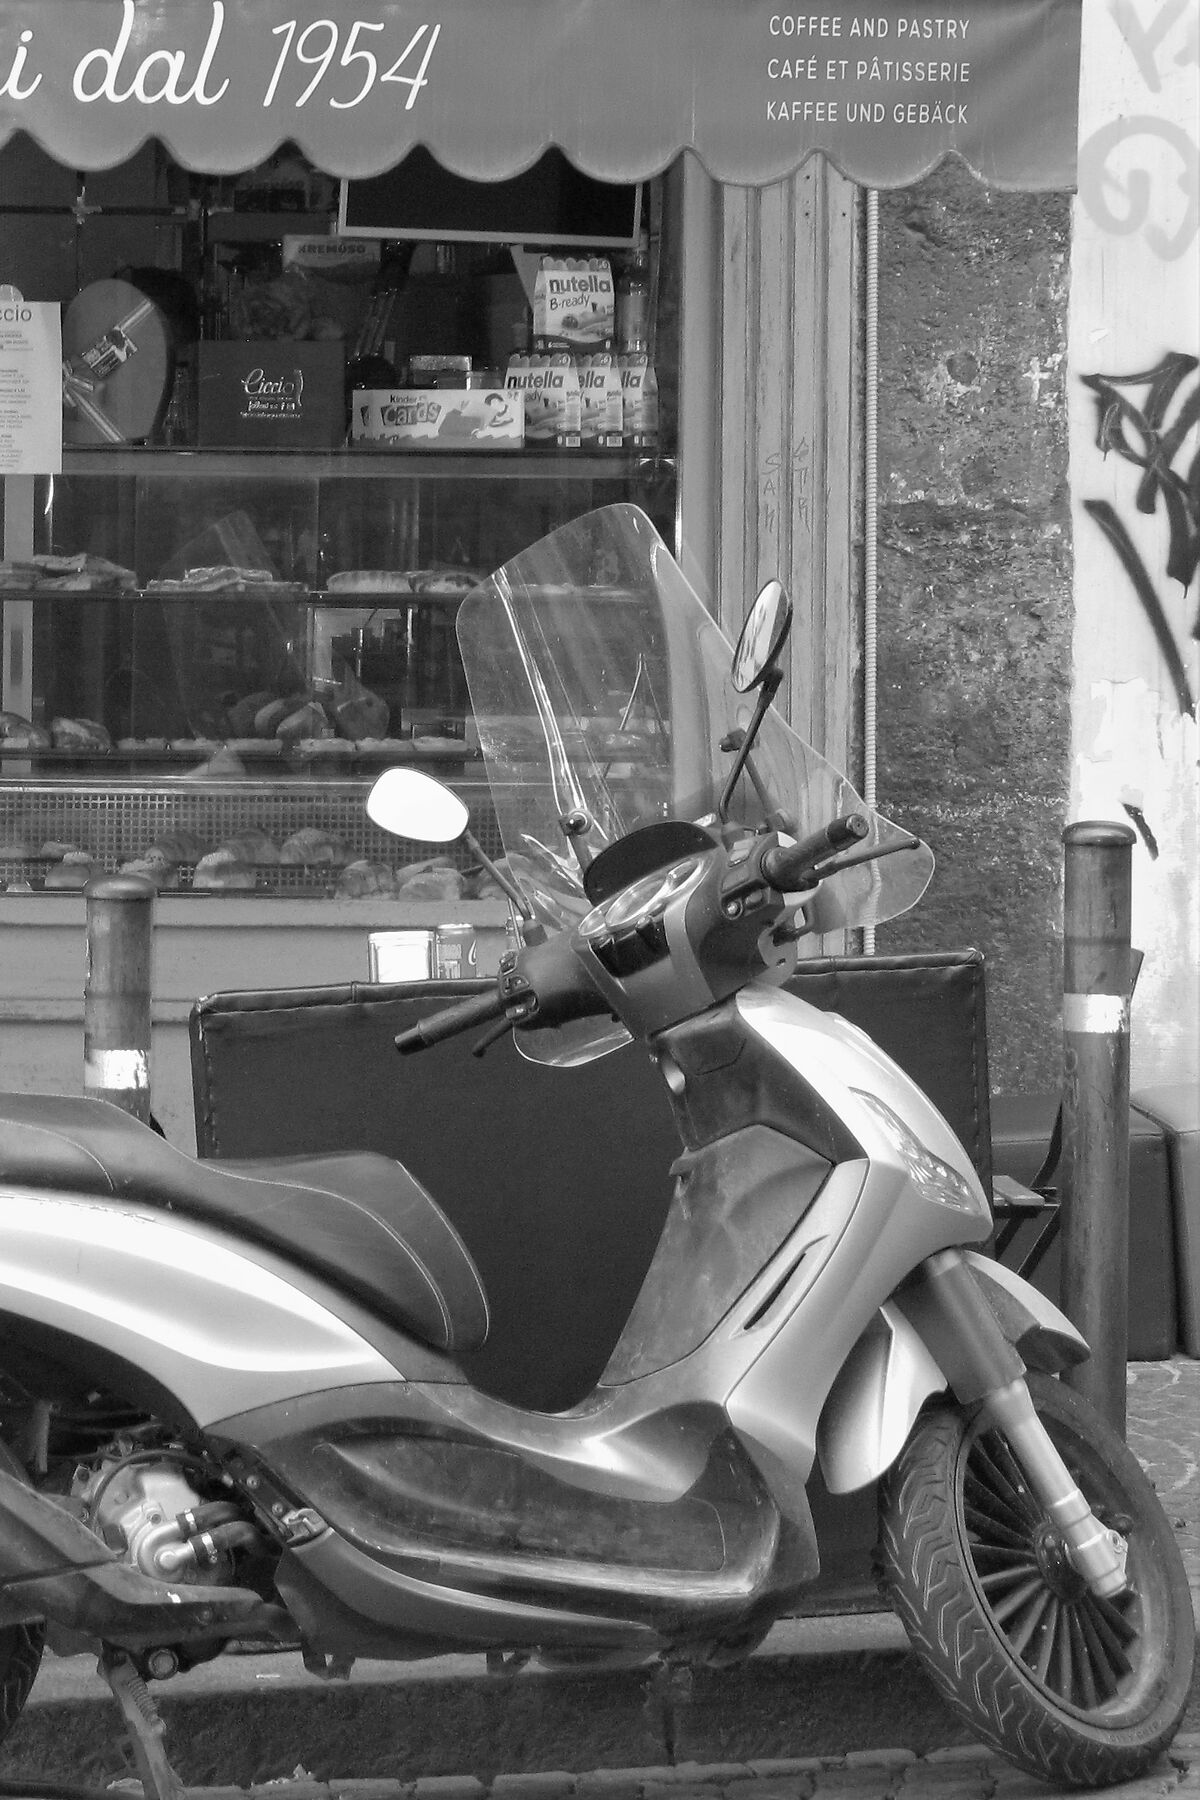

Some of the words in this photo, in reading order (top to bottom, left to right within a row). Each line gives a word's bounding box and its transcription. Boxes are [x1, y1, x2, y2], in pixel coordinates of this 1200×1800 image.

[769, 15, 842, 38] COFFEE
[849, 17, 889, 39] AND
[897, 18, 970, 40] PASTRY
[72, 0, 230, 106] dal
[261, 19, 442, 110] 1954
[767, 54, 818, 80] CAFÉ
[826, 60, 849, 81] ET
[856, 55, 971, 82] PÂTISSERIE
[766, 101, 838, 122] KAFFEE
[846, 102, 886, 124] UND
[893, 100, 969, 125] GEBÄCK
[549, 275, 612, 295] nutella
[240, 368, 295, 395] Ciccio
[507, 371, 564, 389] nutella
